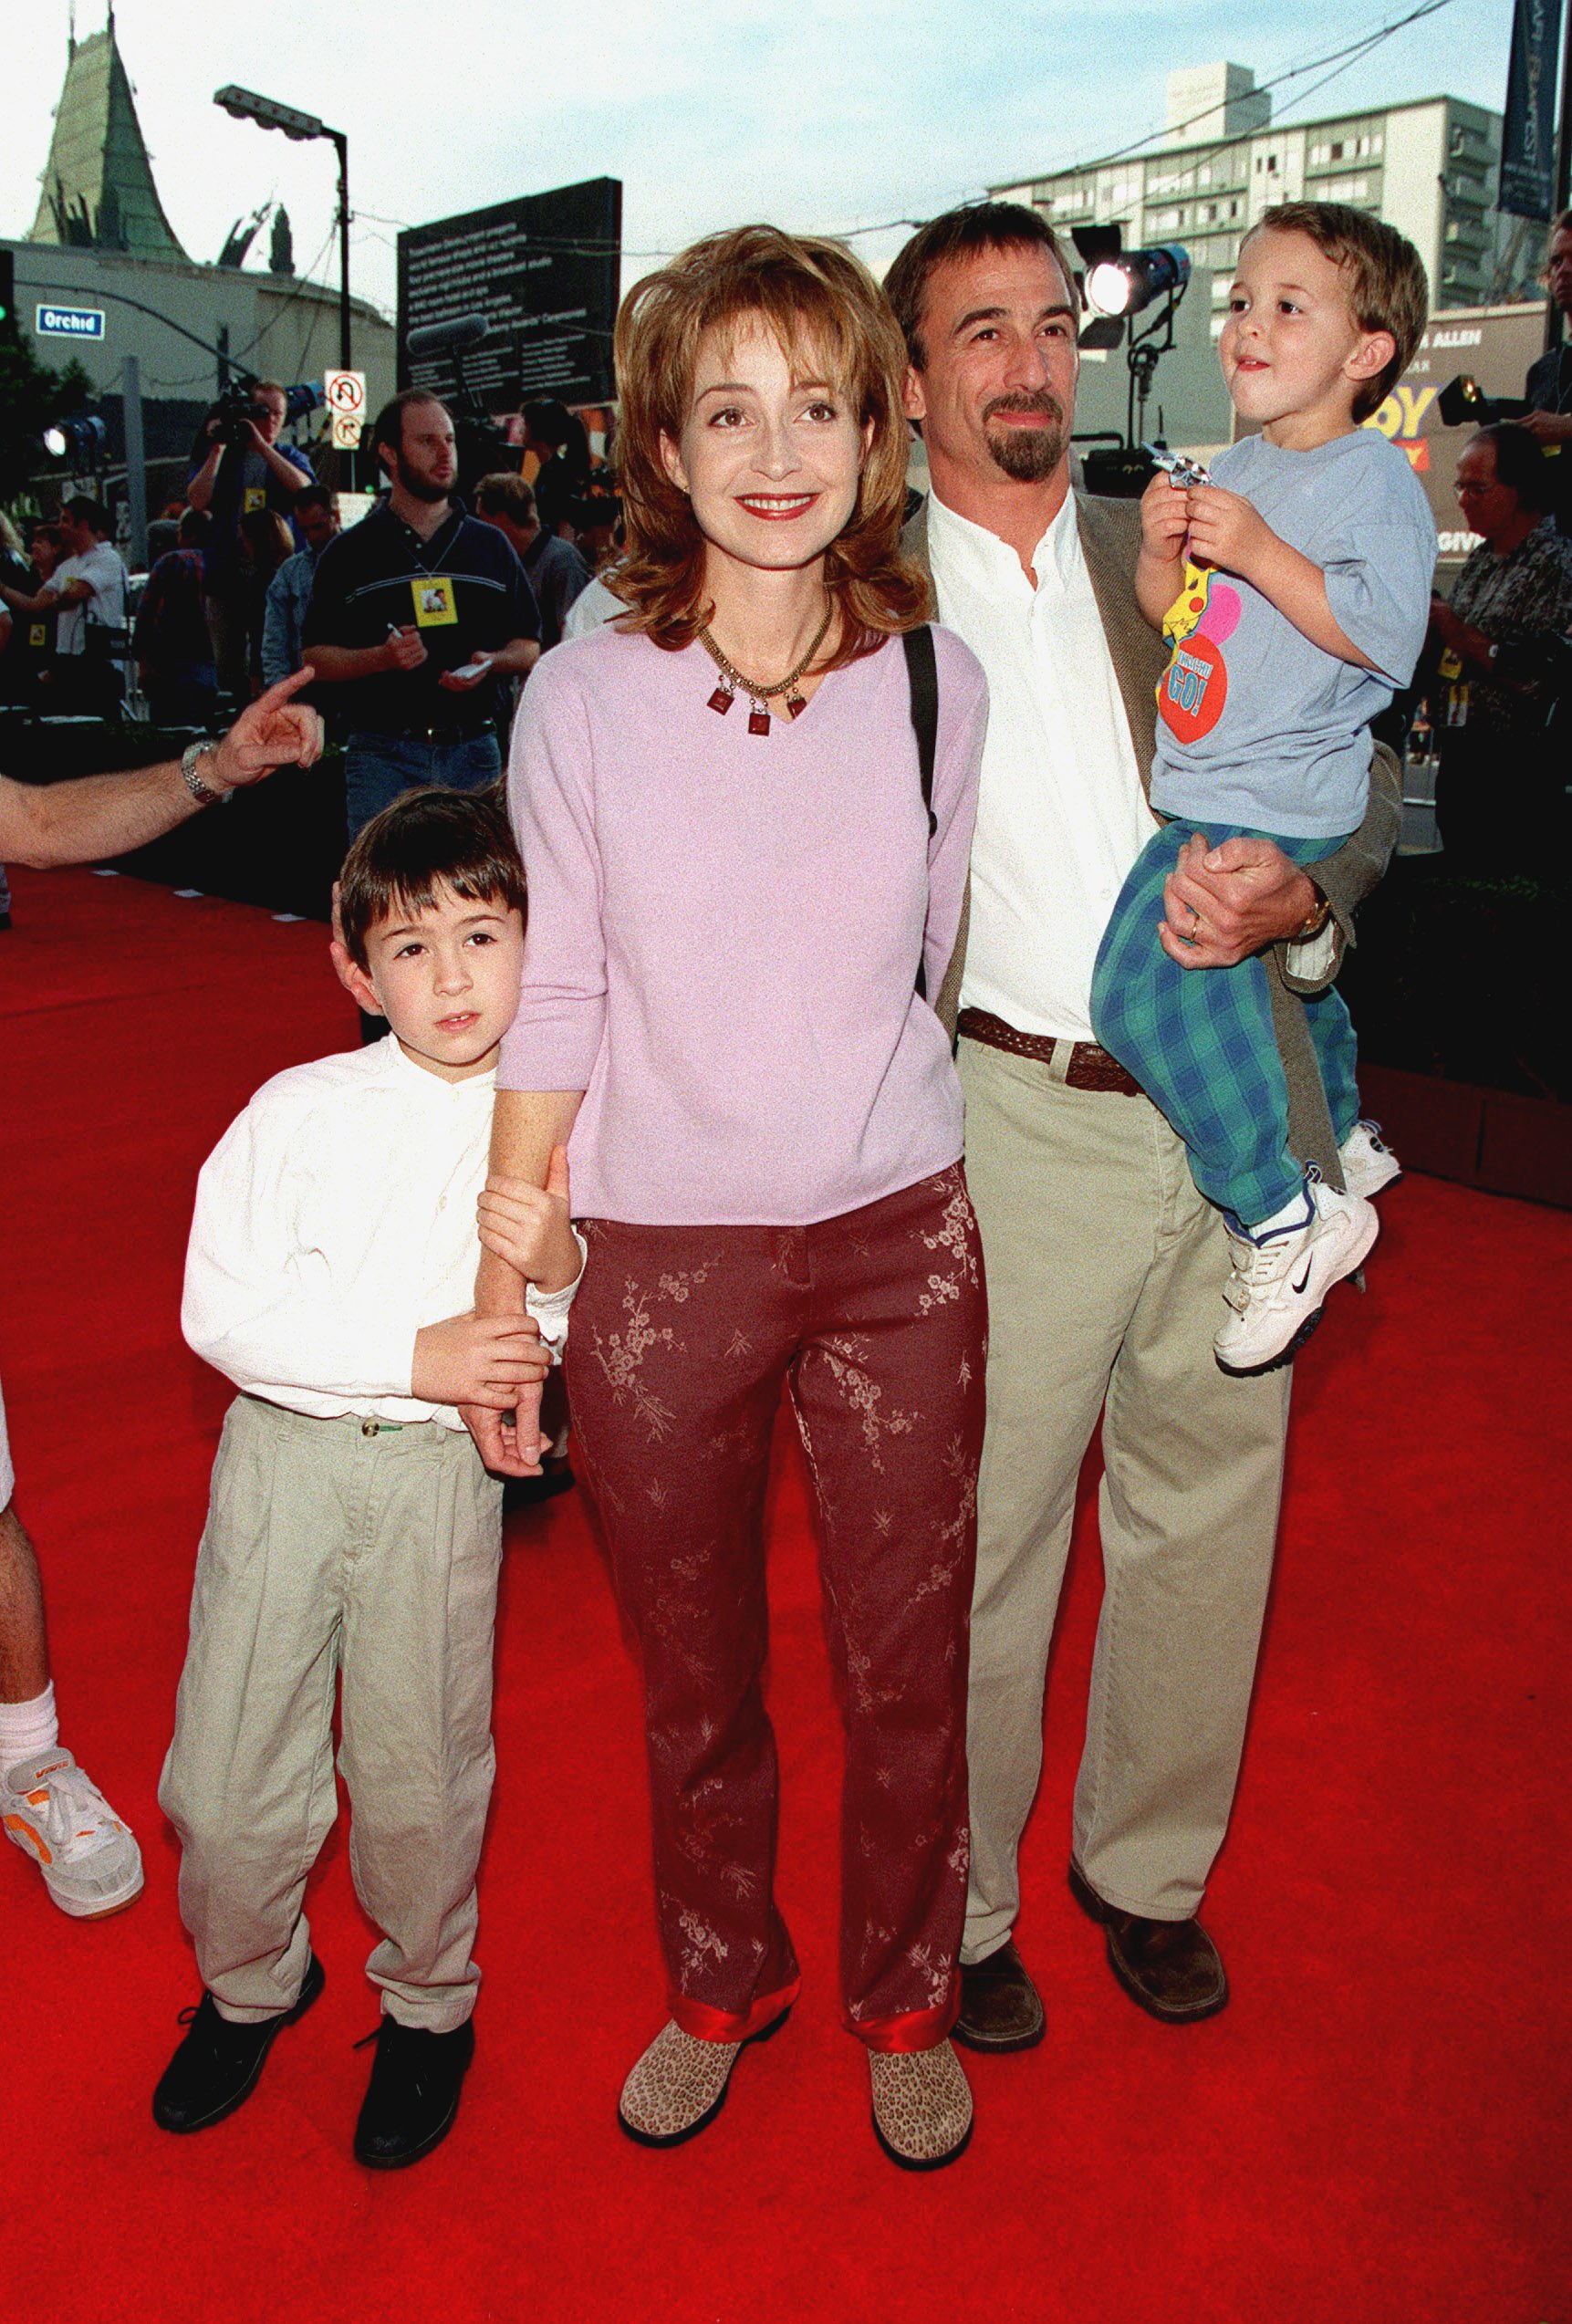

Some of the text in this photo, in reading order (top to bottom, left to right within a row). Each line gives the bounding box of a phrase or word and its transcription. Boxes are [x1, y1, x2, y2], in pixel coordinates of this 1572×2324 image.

[44, 310, 95, 332] Orchid
[1432, 329, 1482, 349] ALLEN
[1362, 385, 1439, 438] OY
[1168, 663, 1208, 718] GO!
